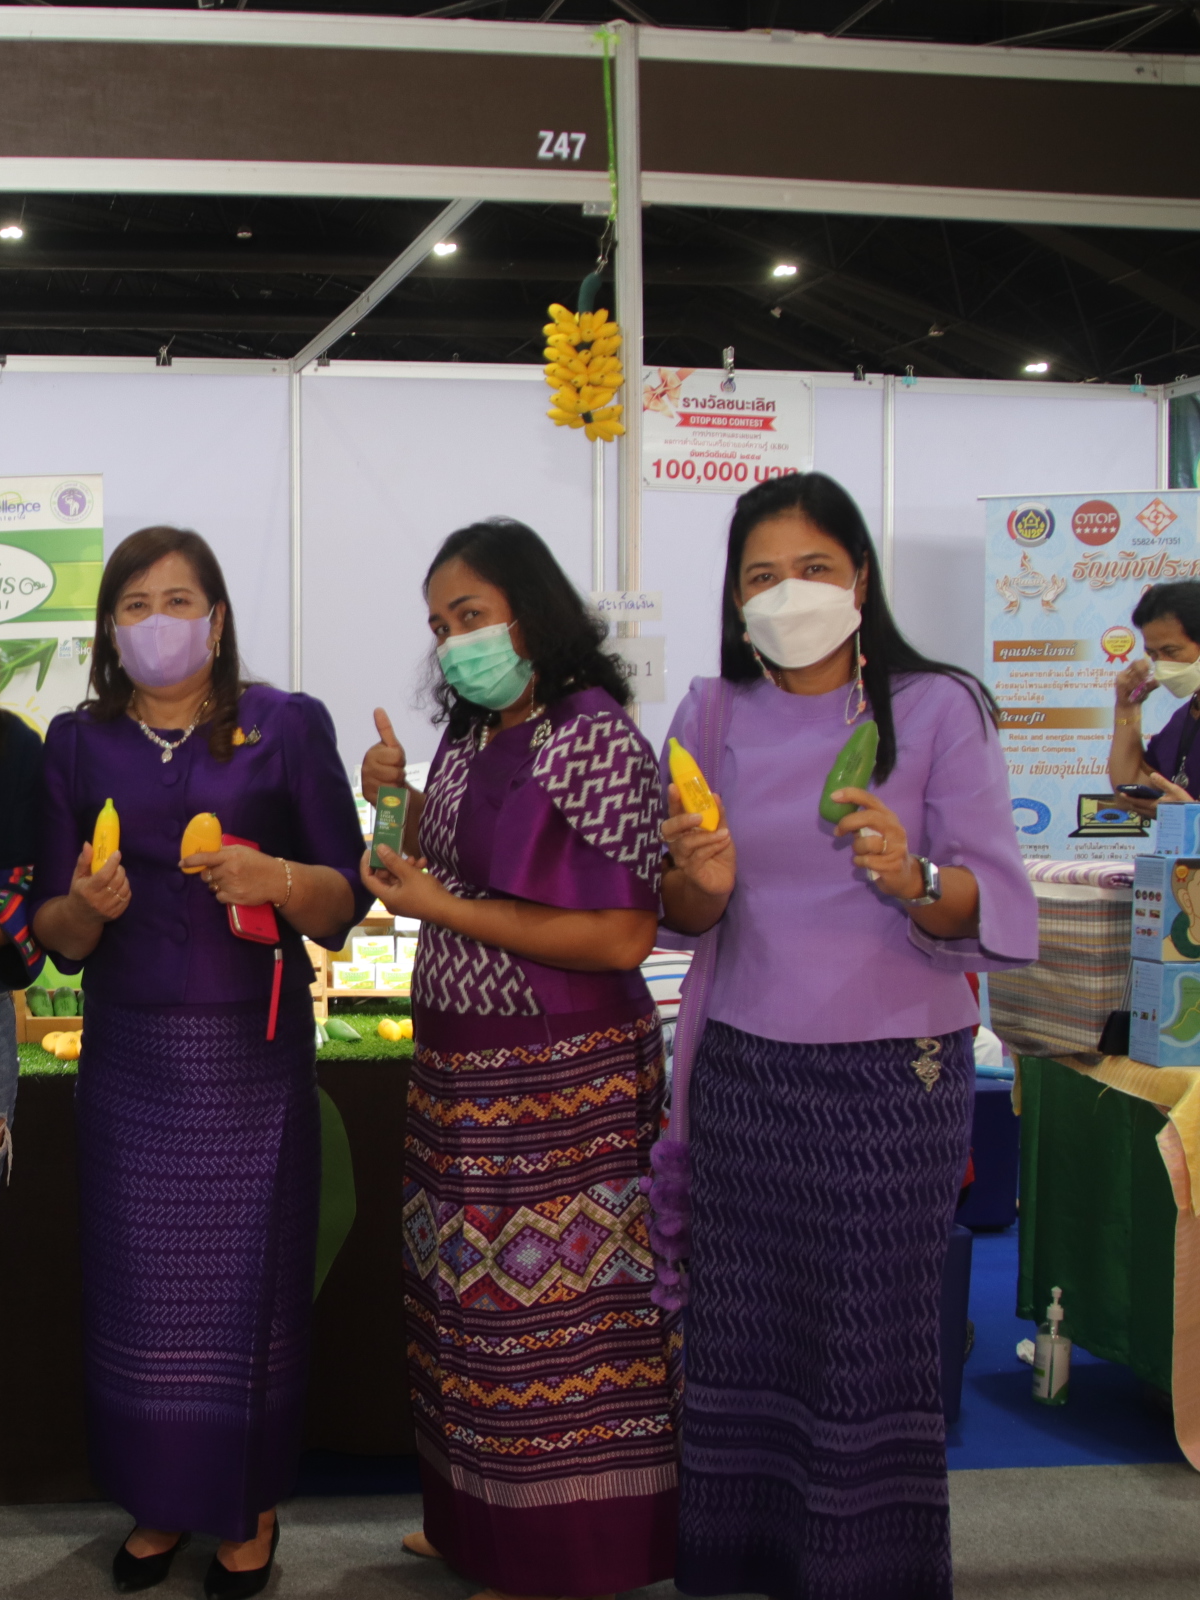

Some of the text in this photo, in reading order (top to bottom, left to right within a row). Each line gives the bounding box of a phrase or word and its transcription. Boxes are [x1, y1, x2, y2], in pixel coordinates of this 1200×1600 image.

[537, 130, 586, 160] Z47
[682, 394, 776, 412] รางวัลชนะเลิศ
[690, 415, 764, 428] OTOP KBO CONTEST
[652, 458, 749, 484] 100,000
[1074, 512, 1118, 525] OTOP
[75, 647, 93, 655] SHO
[1000, 642, 1078, 660] คุณประโยชน์
[645, 661, 653, 677] 1
[1009, 666, 1075, 678] ผ่อนคลายกล้ามเนื้อ
[999, 711, 1047, 725] Benefit
[1046, 733, 1075, 742] energize
[1042, 746, 1076, 754] Compress
